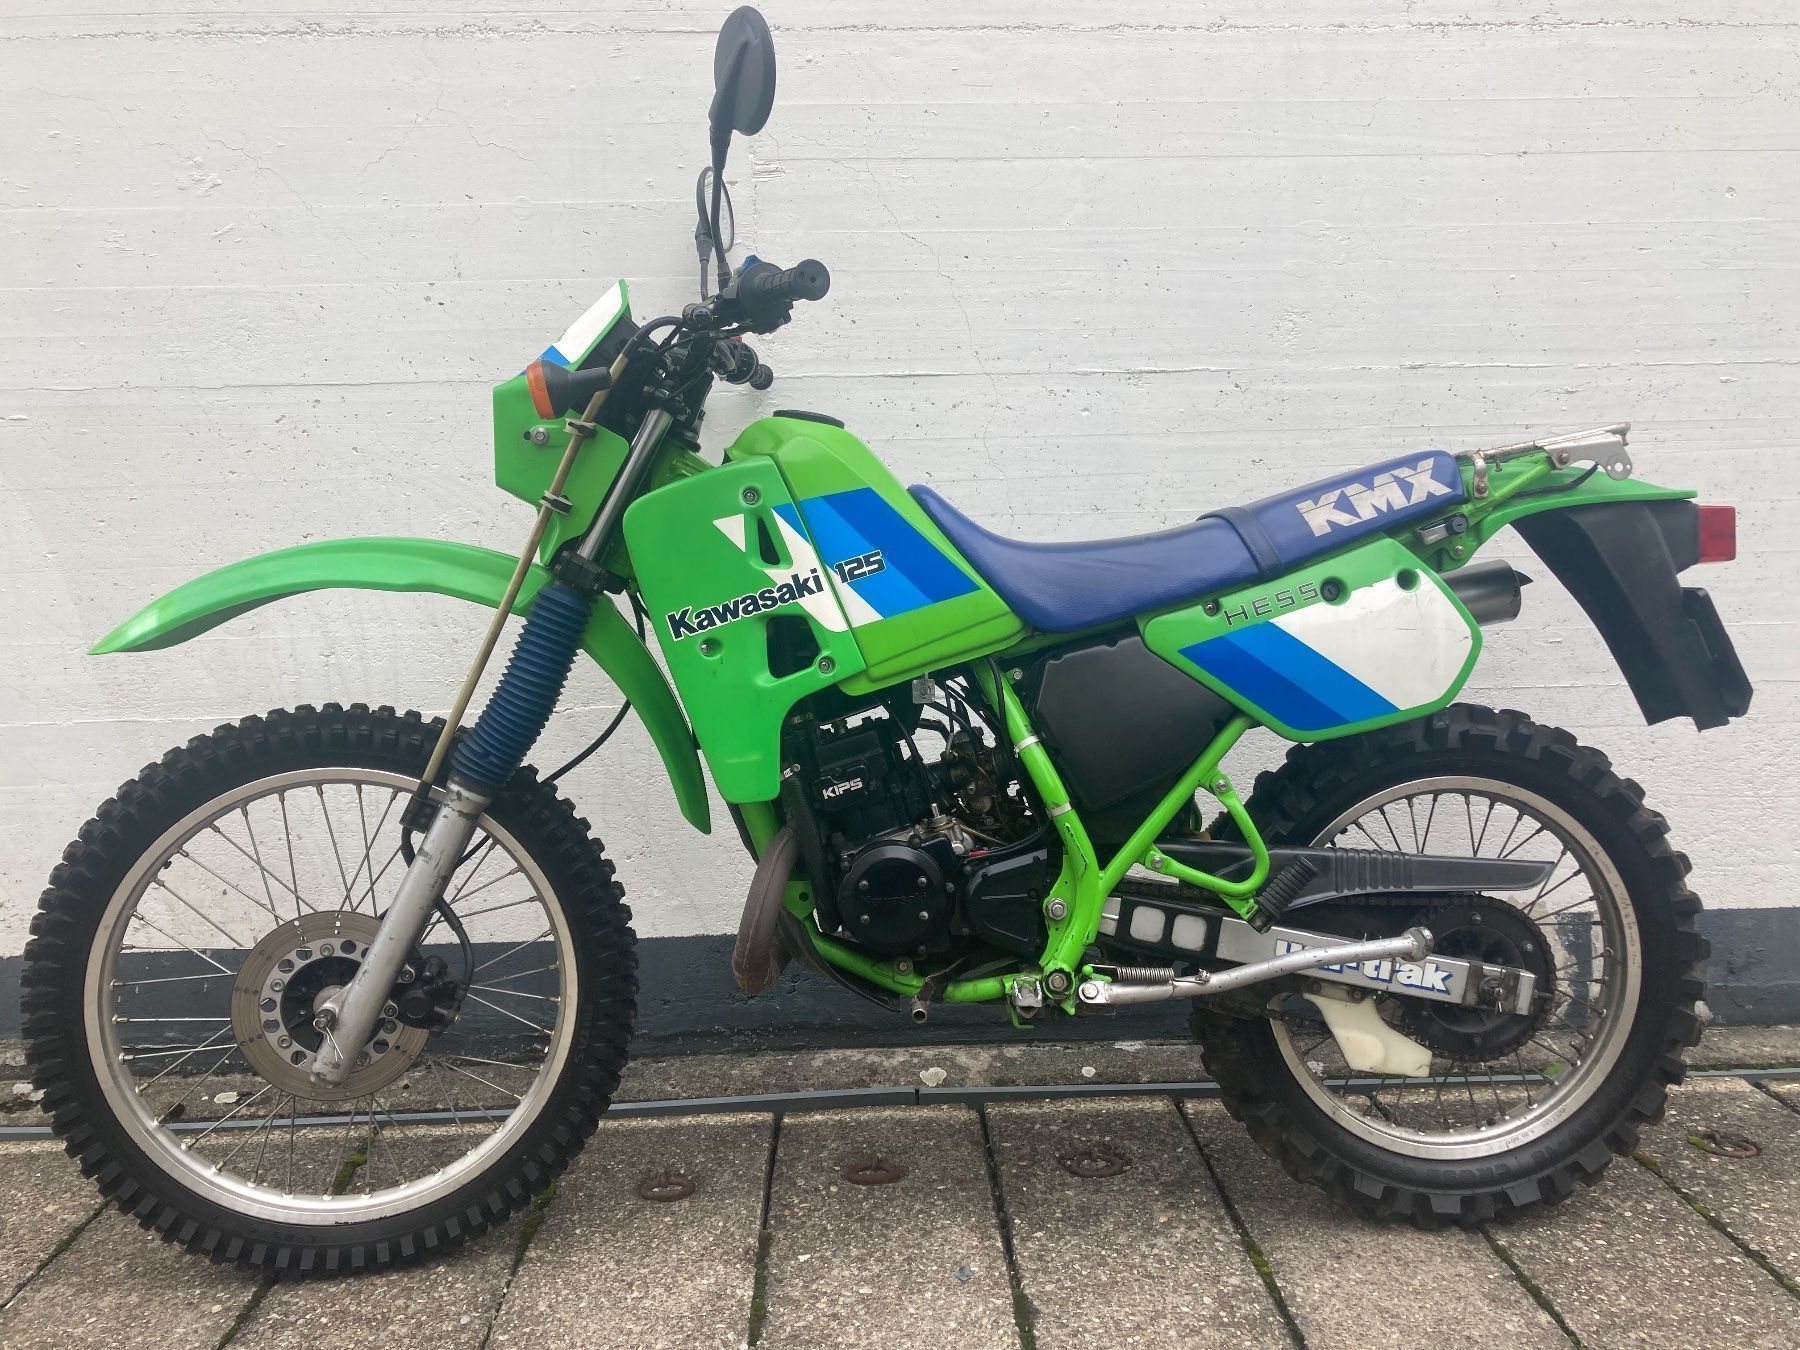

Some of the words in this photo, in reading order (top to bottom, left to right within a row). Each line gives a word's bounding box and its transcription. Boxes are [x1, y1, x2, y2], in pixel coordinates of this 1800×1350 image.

[1295, 457, 1453, 537] KMX
[833, 549, 887, 584] 125
[666, 568, 824, 641] Kawasaki
[1223, 581, 1320, 626] HESS
[822, 777, 863, 800] KIPS
